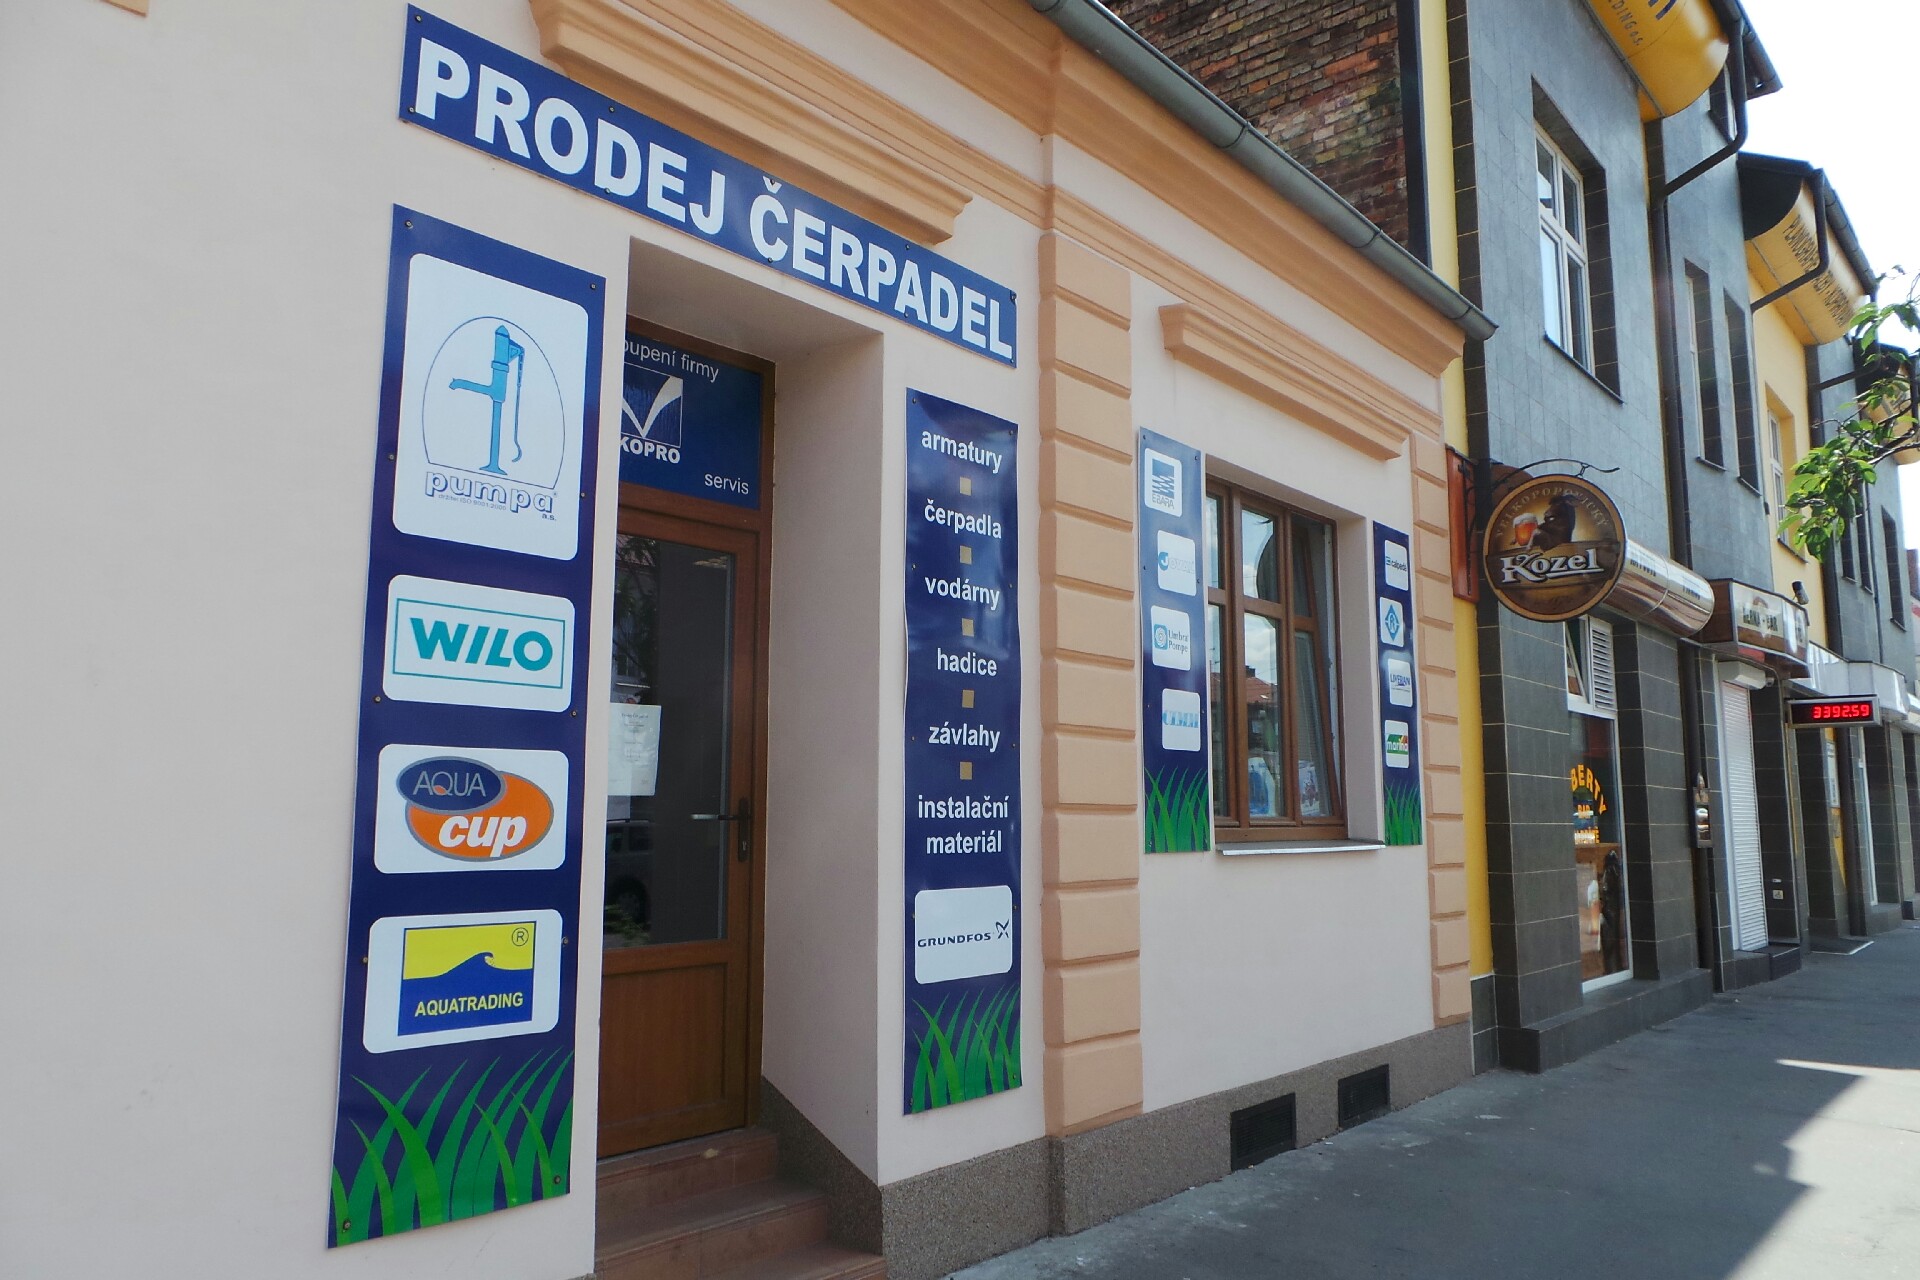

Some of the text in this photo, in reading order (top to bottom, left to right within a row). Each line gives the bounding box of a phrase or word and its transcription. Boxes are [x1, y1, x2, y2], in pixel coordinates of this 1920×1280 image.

[415, 37, 1014, 359] PRODEJ ČERPADEL
[681, 354, 719, 383] firmy
[922, 430, 1002, 474] armatury
[425, 472, 553, 513] pumpa
[704, 473, 749, 495] servis
[1152, 493, 1174, 510] EBARA
[924, 498, 1002, 539] čerpadla
[1501, 548, 1604, 583] Kozel
[925, 576, 1000, 610] vodárny
[410, 617, 553, 671] WILO
[937, 647, 997, 677] hadice
[928, 721, 1001, 752] závlahy
[413, 770, 486, 797] AQUA
[918, 795, 1008, 819] instalační
[439, 815, 527, 857] cup
[926, 830, 1002, 854] materiál
[917, 931, 992, 948] GRUNDFOS
[414, 992, 523, 1017] AQUATRADING
